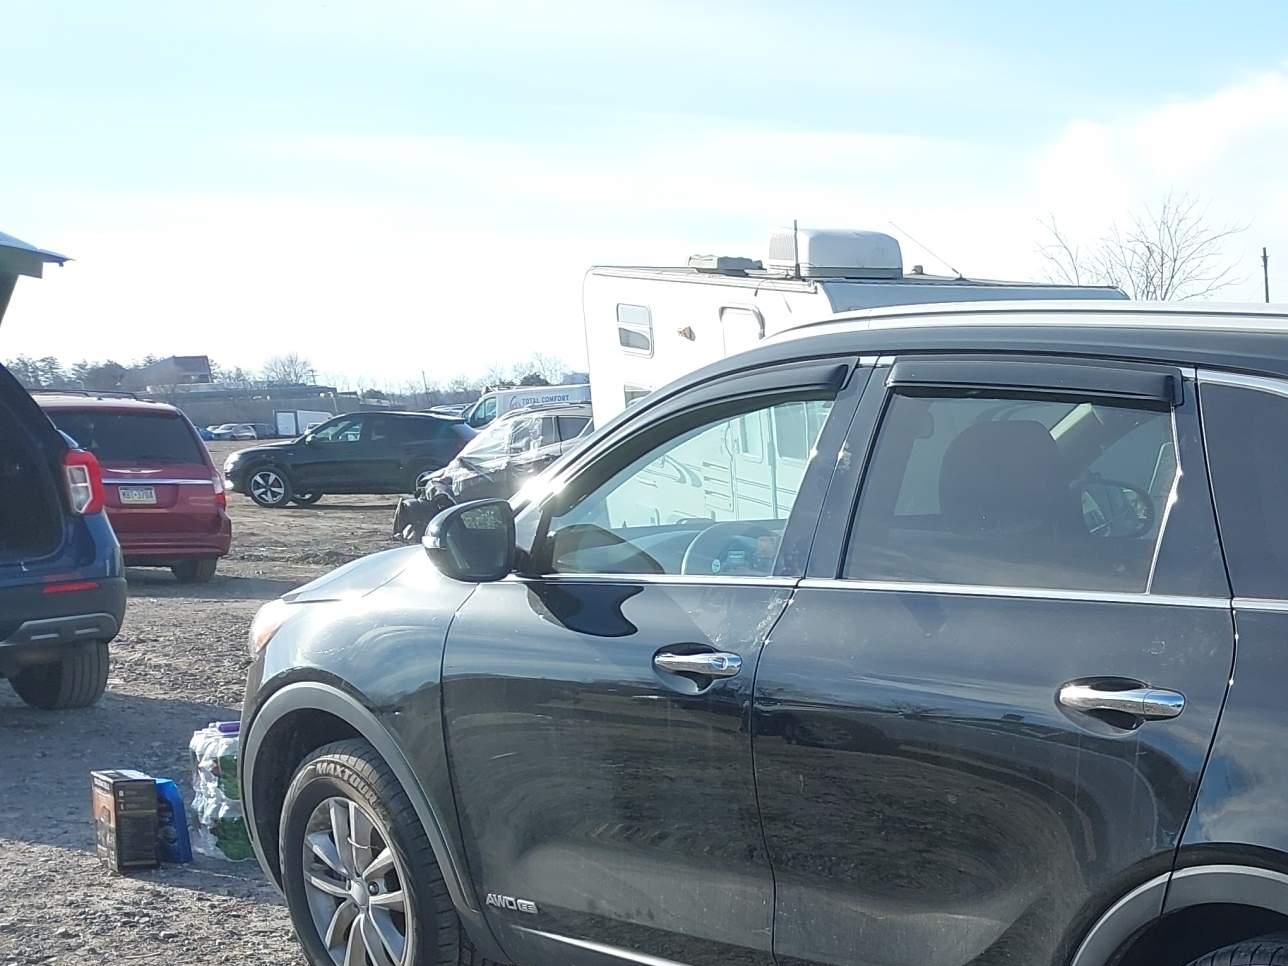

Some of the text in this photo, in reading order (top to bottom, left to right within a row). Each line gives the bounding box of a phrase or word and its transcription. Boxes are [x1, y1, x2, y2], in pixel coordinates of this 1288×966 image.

[522, 394, 569, 405] TOTAL COMFORT
[315, 762, 378, 808] MAXTOUR
[486, 893, 517, 910] AWD
